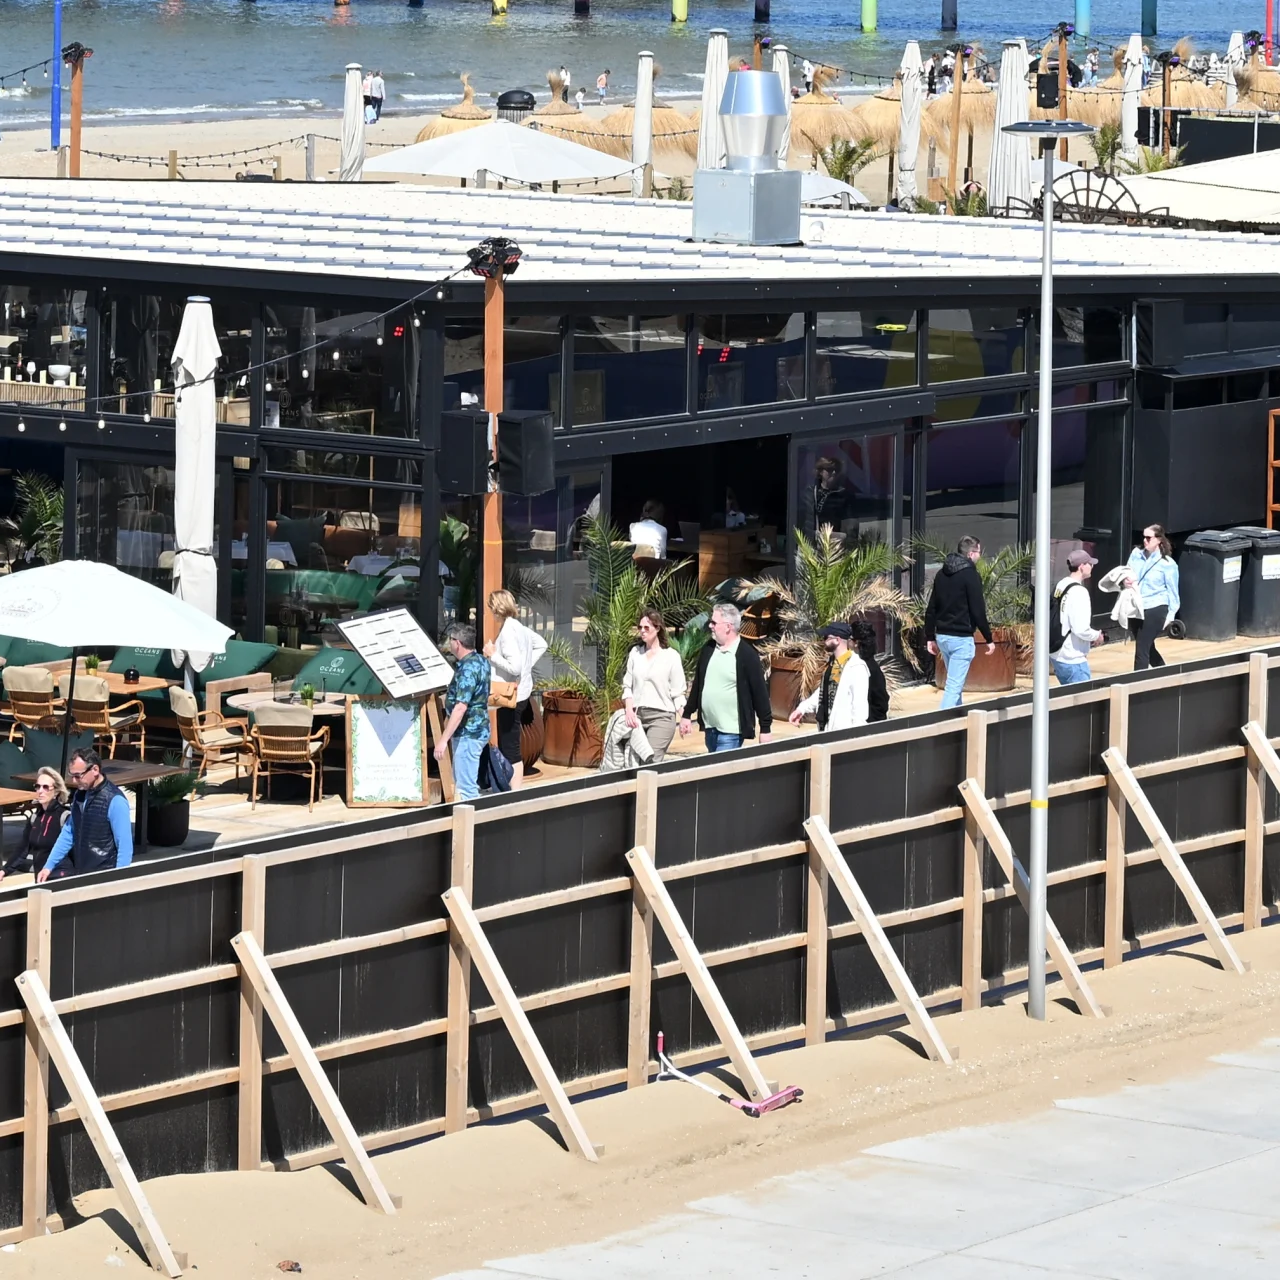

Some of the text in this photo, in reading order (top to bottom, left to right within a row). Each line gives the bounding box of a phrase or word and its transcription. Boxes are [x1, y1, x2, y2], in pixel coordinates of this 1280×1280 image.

[281, 409, 299, 417] EANS
[134, 647, 160, 655] OCEANS
[320, 666, 345, 674] OCEANS
